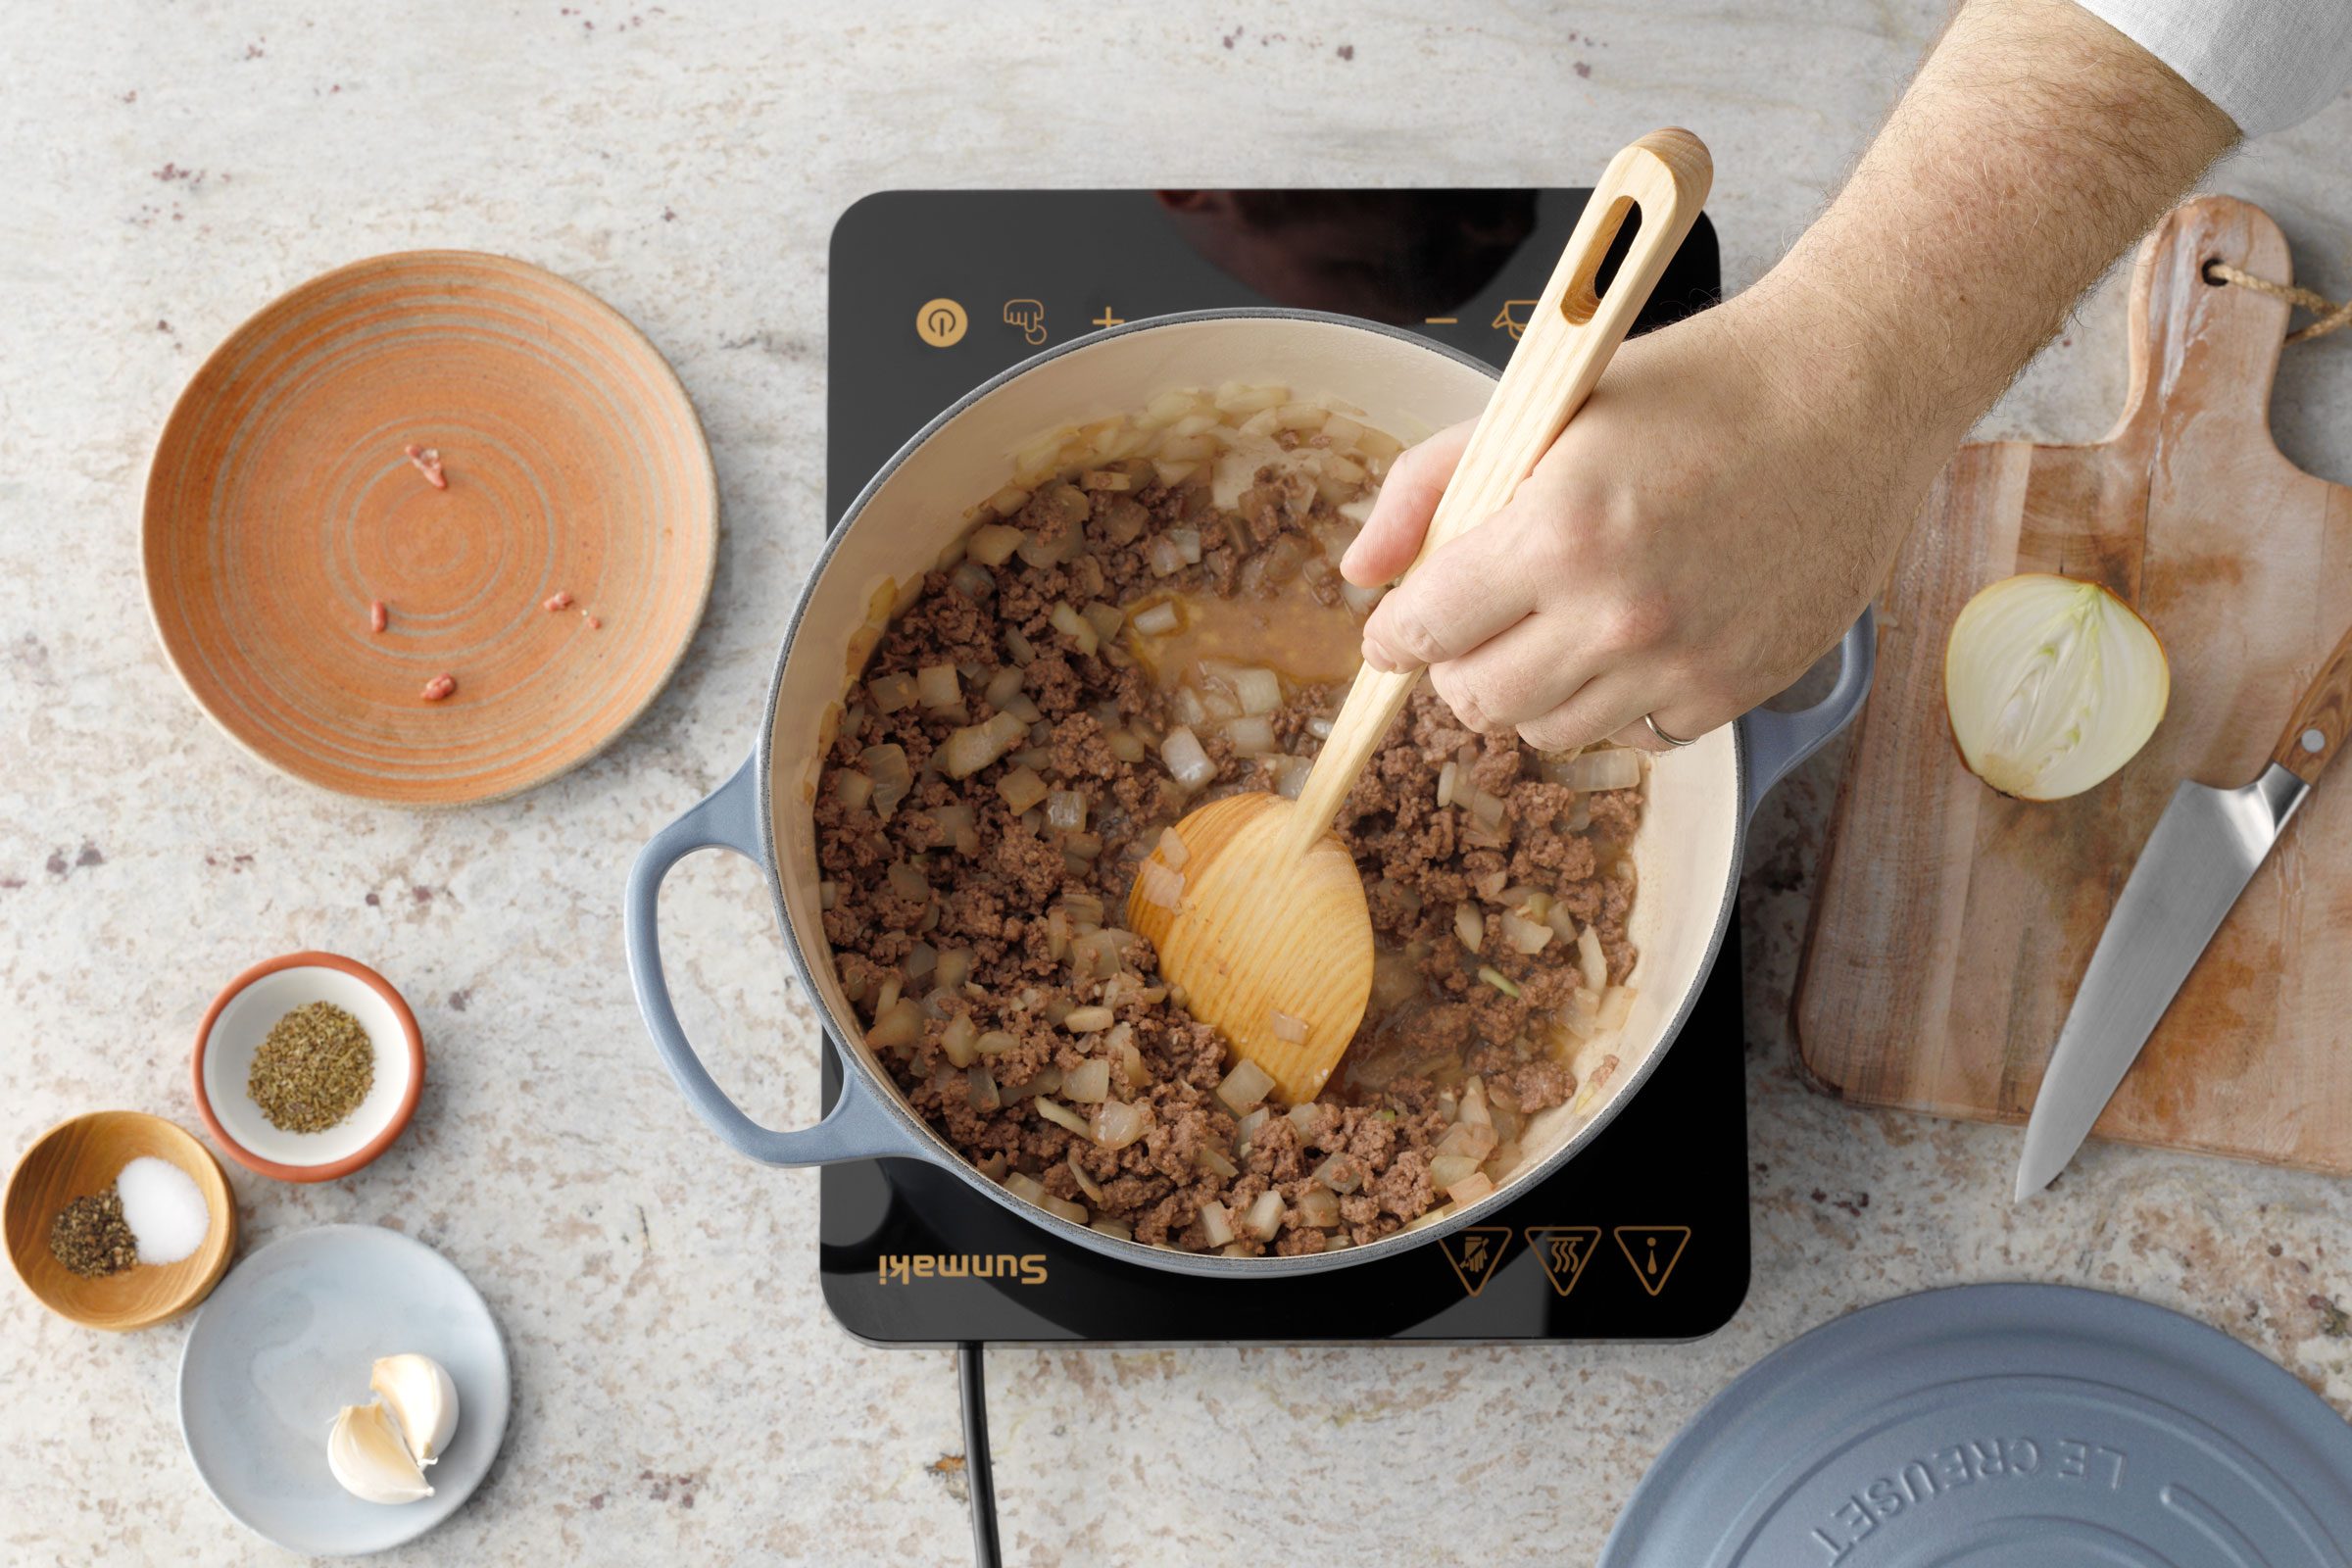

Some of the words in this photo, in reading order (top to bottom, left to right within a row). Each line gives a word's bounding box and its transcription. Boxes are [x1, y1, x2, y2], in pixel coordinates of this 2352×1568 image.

[879, 1254, 1048, 1285] Sunmaki
[2058, 1439, 2128, 1491] LE
[1811, 1436, 2039, 1567] CREUSET
